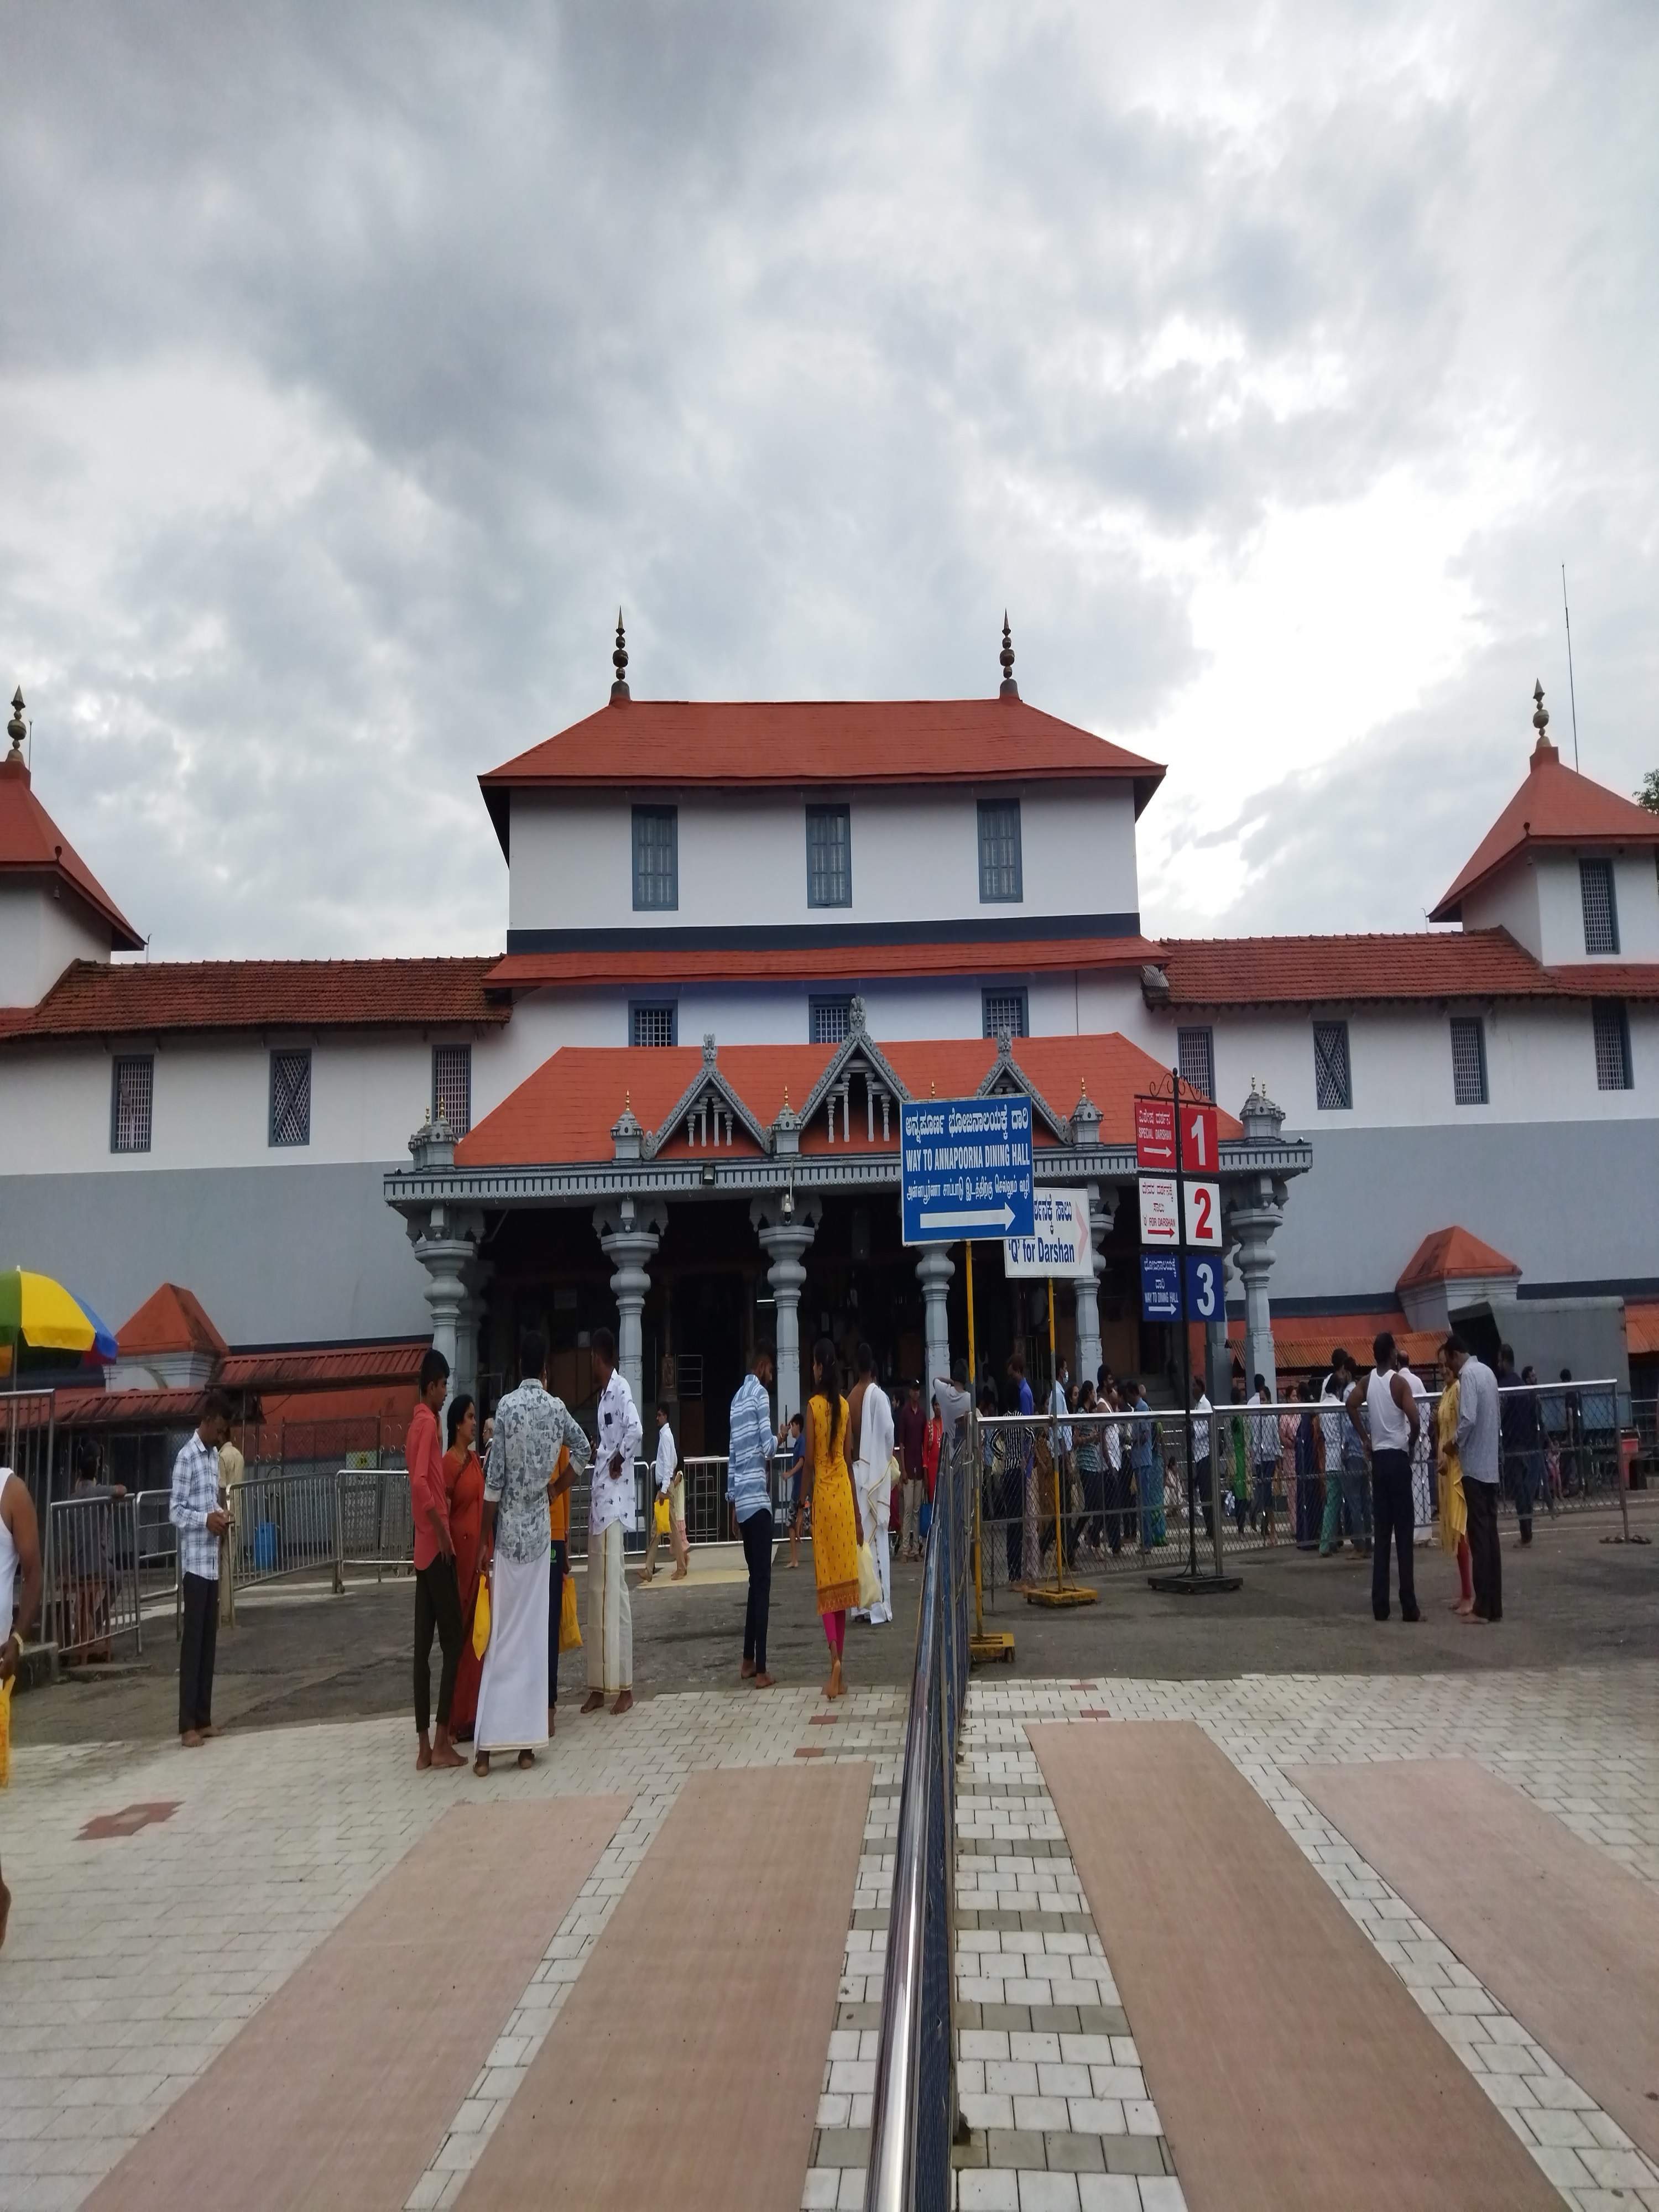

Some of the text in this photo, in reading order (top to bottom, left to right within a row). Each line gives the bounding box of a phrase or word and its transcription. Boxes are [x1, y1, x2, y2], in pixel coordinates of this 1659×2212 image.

[906, 1104, 1029, 1144] ಅನ್ನಪೂರ್ಣ ಭೋಜನಾಲಯಕ್ಕೆ ದಾರಿ
[1155, 1111, 1171, 1126] ದರ್ಶನ
[1138, 1127, 1172, 1141] SPECIAL DARSHAN
[1191, 1115, 1206, 1166] 1
[906, 1143, 1030, 1172] WAY TO ANNAPOORNA DINING HALL
[906, 1172, 1030, 1205] அன்னபூர்ணா சாப்பாடு இடத்திற்கு செல்லும் வழி
[1055, 1201, 1072, 1221] ಸಾಲು
[1157, 1217, 1176, 1227] DARSHAN
[1194, 1188, 1213, 1239] 2
[1023, 1239, 1035, 1262] for
[1037, 1237, 1075, 1263] Darshan
[1152, 1292, 1157, 1303] TO
[1157, 1292, 1169, 1303] DINING
[1169, 1291, 1179, 1303] HALL
[1155, 1278, 1166, 1290] ದಾರಿ
[1196, 1263, 1215, 1316] 3
